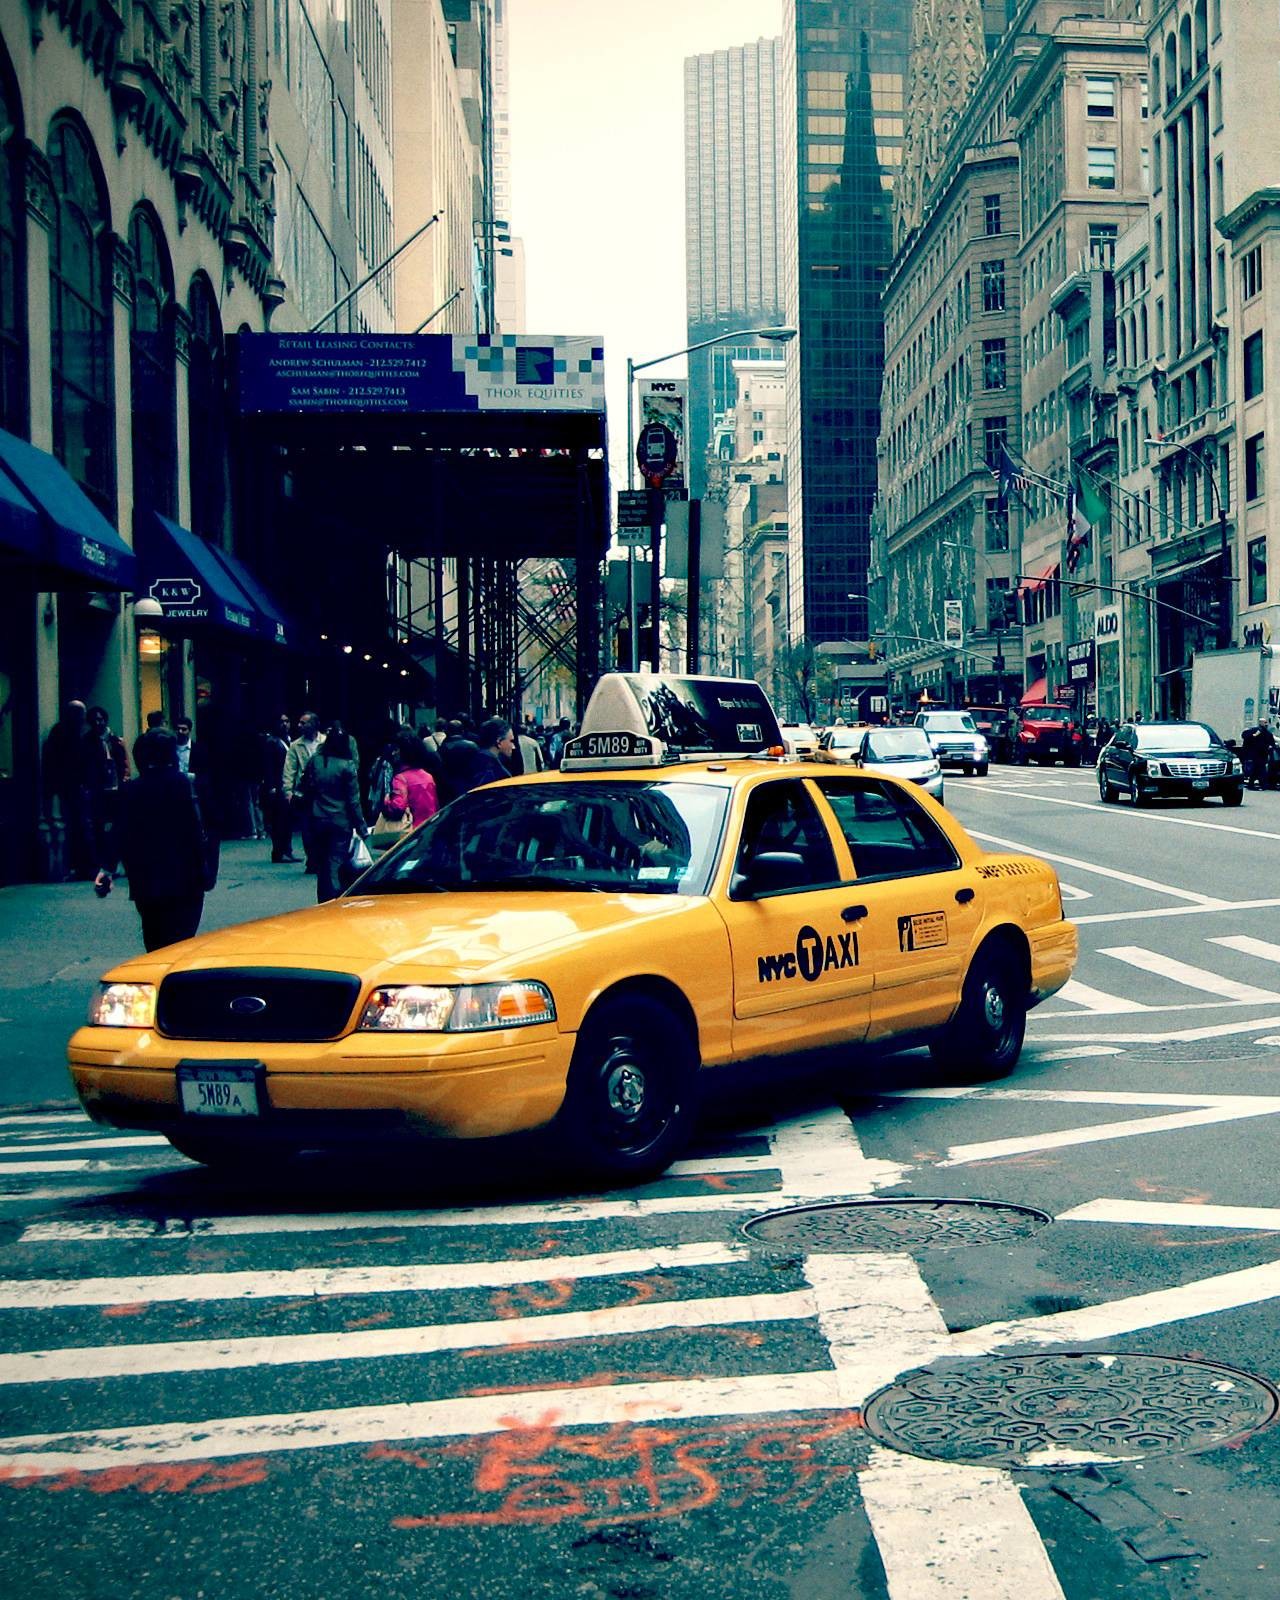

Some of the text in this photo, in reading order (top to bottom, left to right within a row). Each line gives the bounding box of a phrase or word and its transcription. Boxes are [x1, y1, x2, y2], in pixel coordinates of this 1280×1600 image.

[279, 339, 416, 349] RETAIL LEASING CONTACTS:
[268, 359, 310, 367] ANDREW
[311, 359, 363, 367] SCHULMAN
[291, 387, 310, 395] SAM
[312, 387, 340, 395] SABIN
[651, 383, 676, 391] NYC
[486, 388, 584, 400] THOR EQUITIES
[166, 609, 209, 618] JEWELRY
[1097, 612, 1118, 636] ALDO
[588, 736, 630, 754] 5M89
[757, 952, 796, 983] NYC
